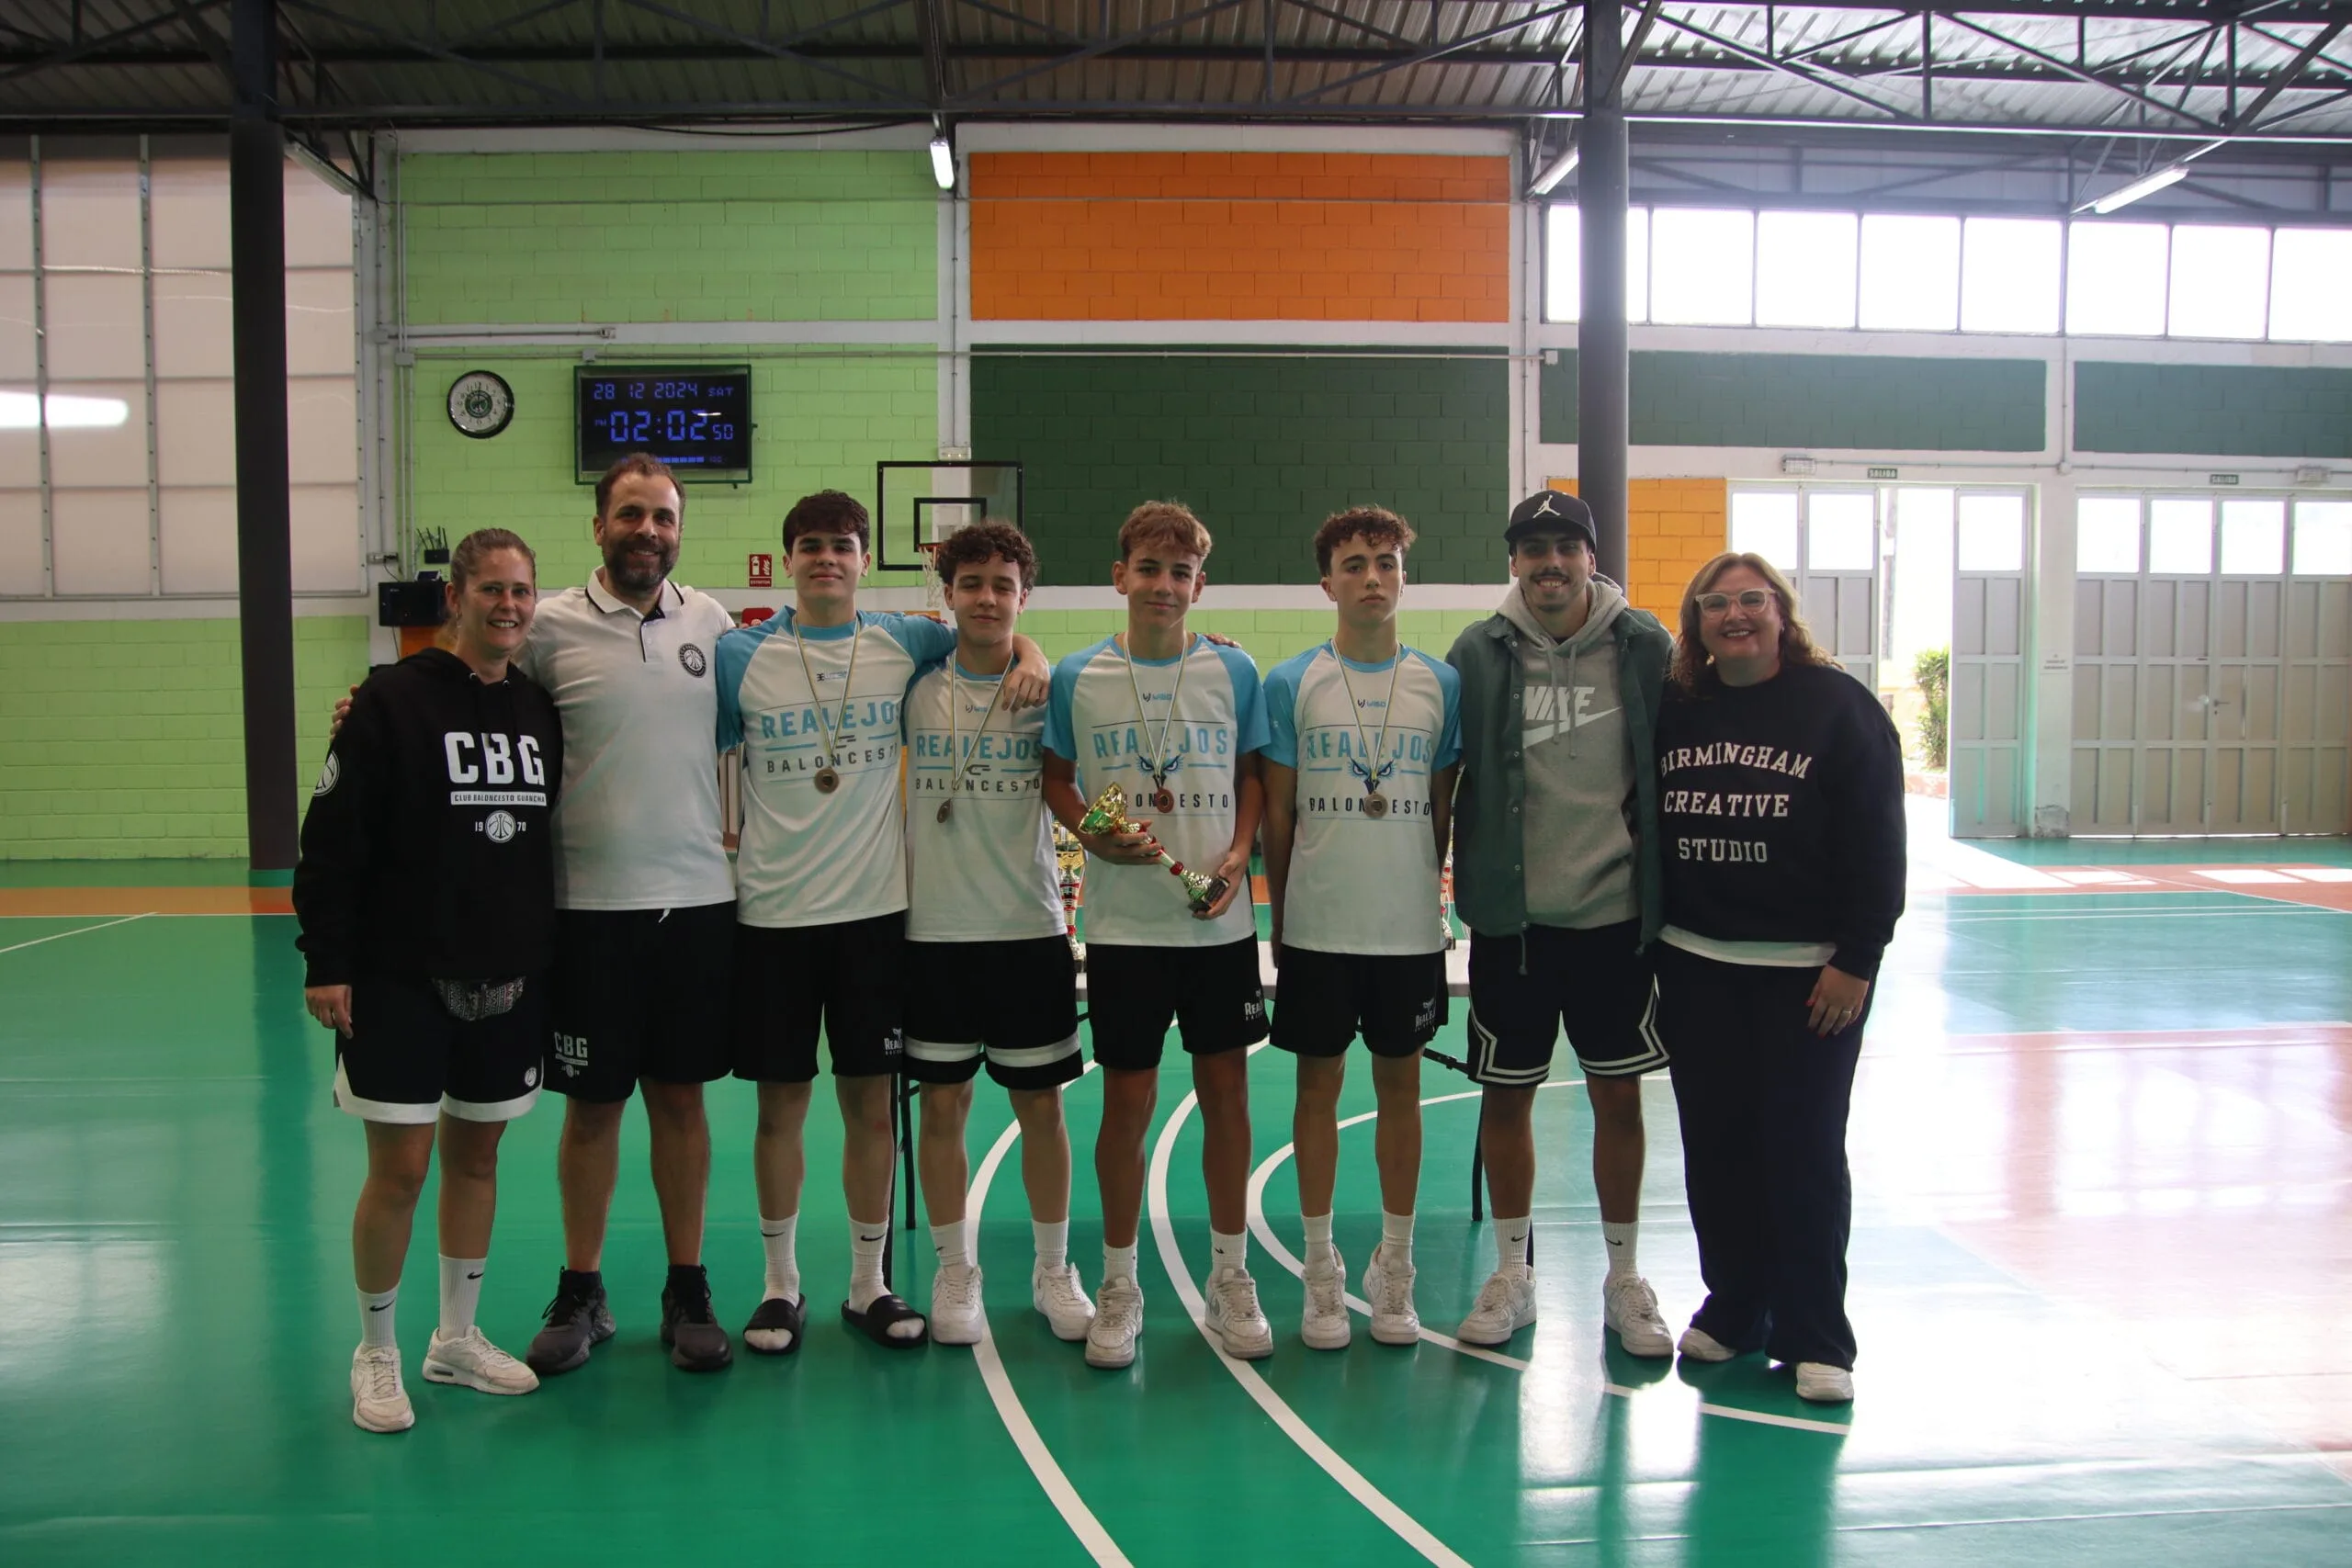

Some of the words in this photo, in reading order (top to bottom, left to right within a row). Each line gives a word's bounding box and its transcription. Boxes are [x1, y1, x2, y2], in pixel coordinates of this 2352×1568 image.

[594, 383, 615, 400] 28
[629, 381, 645, 399] 12
[654, 381, 697, 399] 2024
[708, 387, 733, 397] SAT
[610, 409, 707, 442] 02:02
[712, 423, 733, 440] 50
[1522, 686, 1595, 720] NIKE
[761, 701, 900, 739] REALEJO
[1093, 727, 1227, 758] REAJOS
[445, 732, 545, 785] CBG
[1660, 742, 1813, 779] BIRMINGHAM
[1309, 797, 1431, 816] BALONESTO
[1664, 791, 1790, 818] CREATIVE
[475, 822, 483, 831] 19
[517, 822, 526, 831] 70
[1679, 838, 1768, 863] STUDIO
[554, 1032, 588, 1058] CBG
